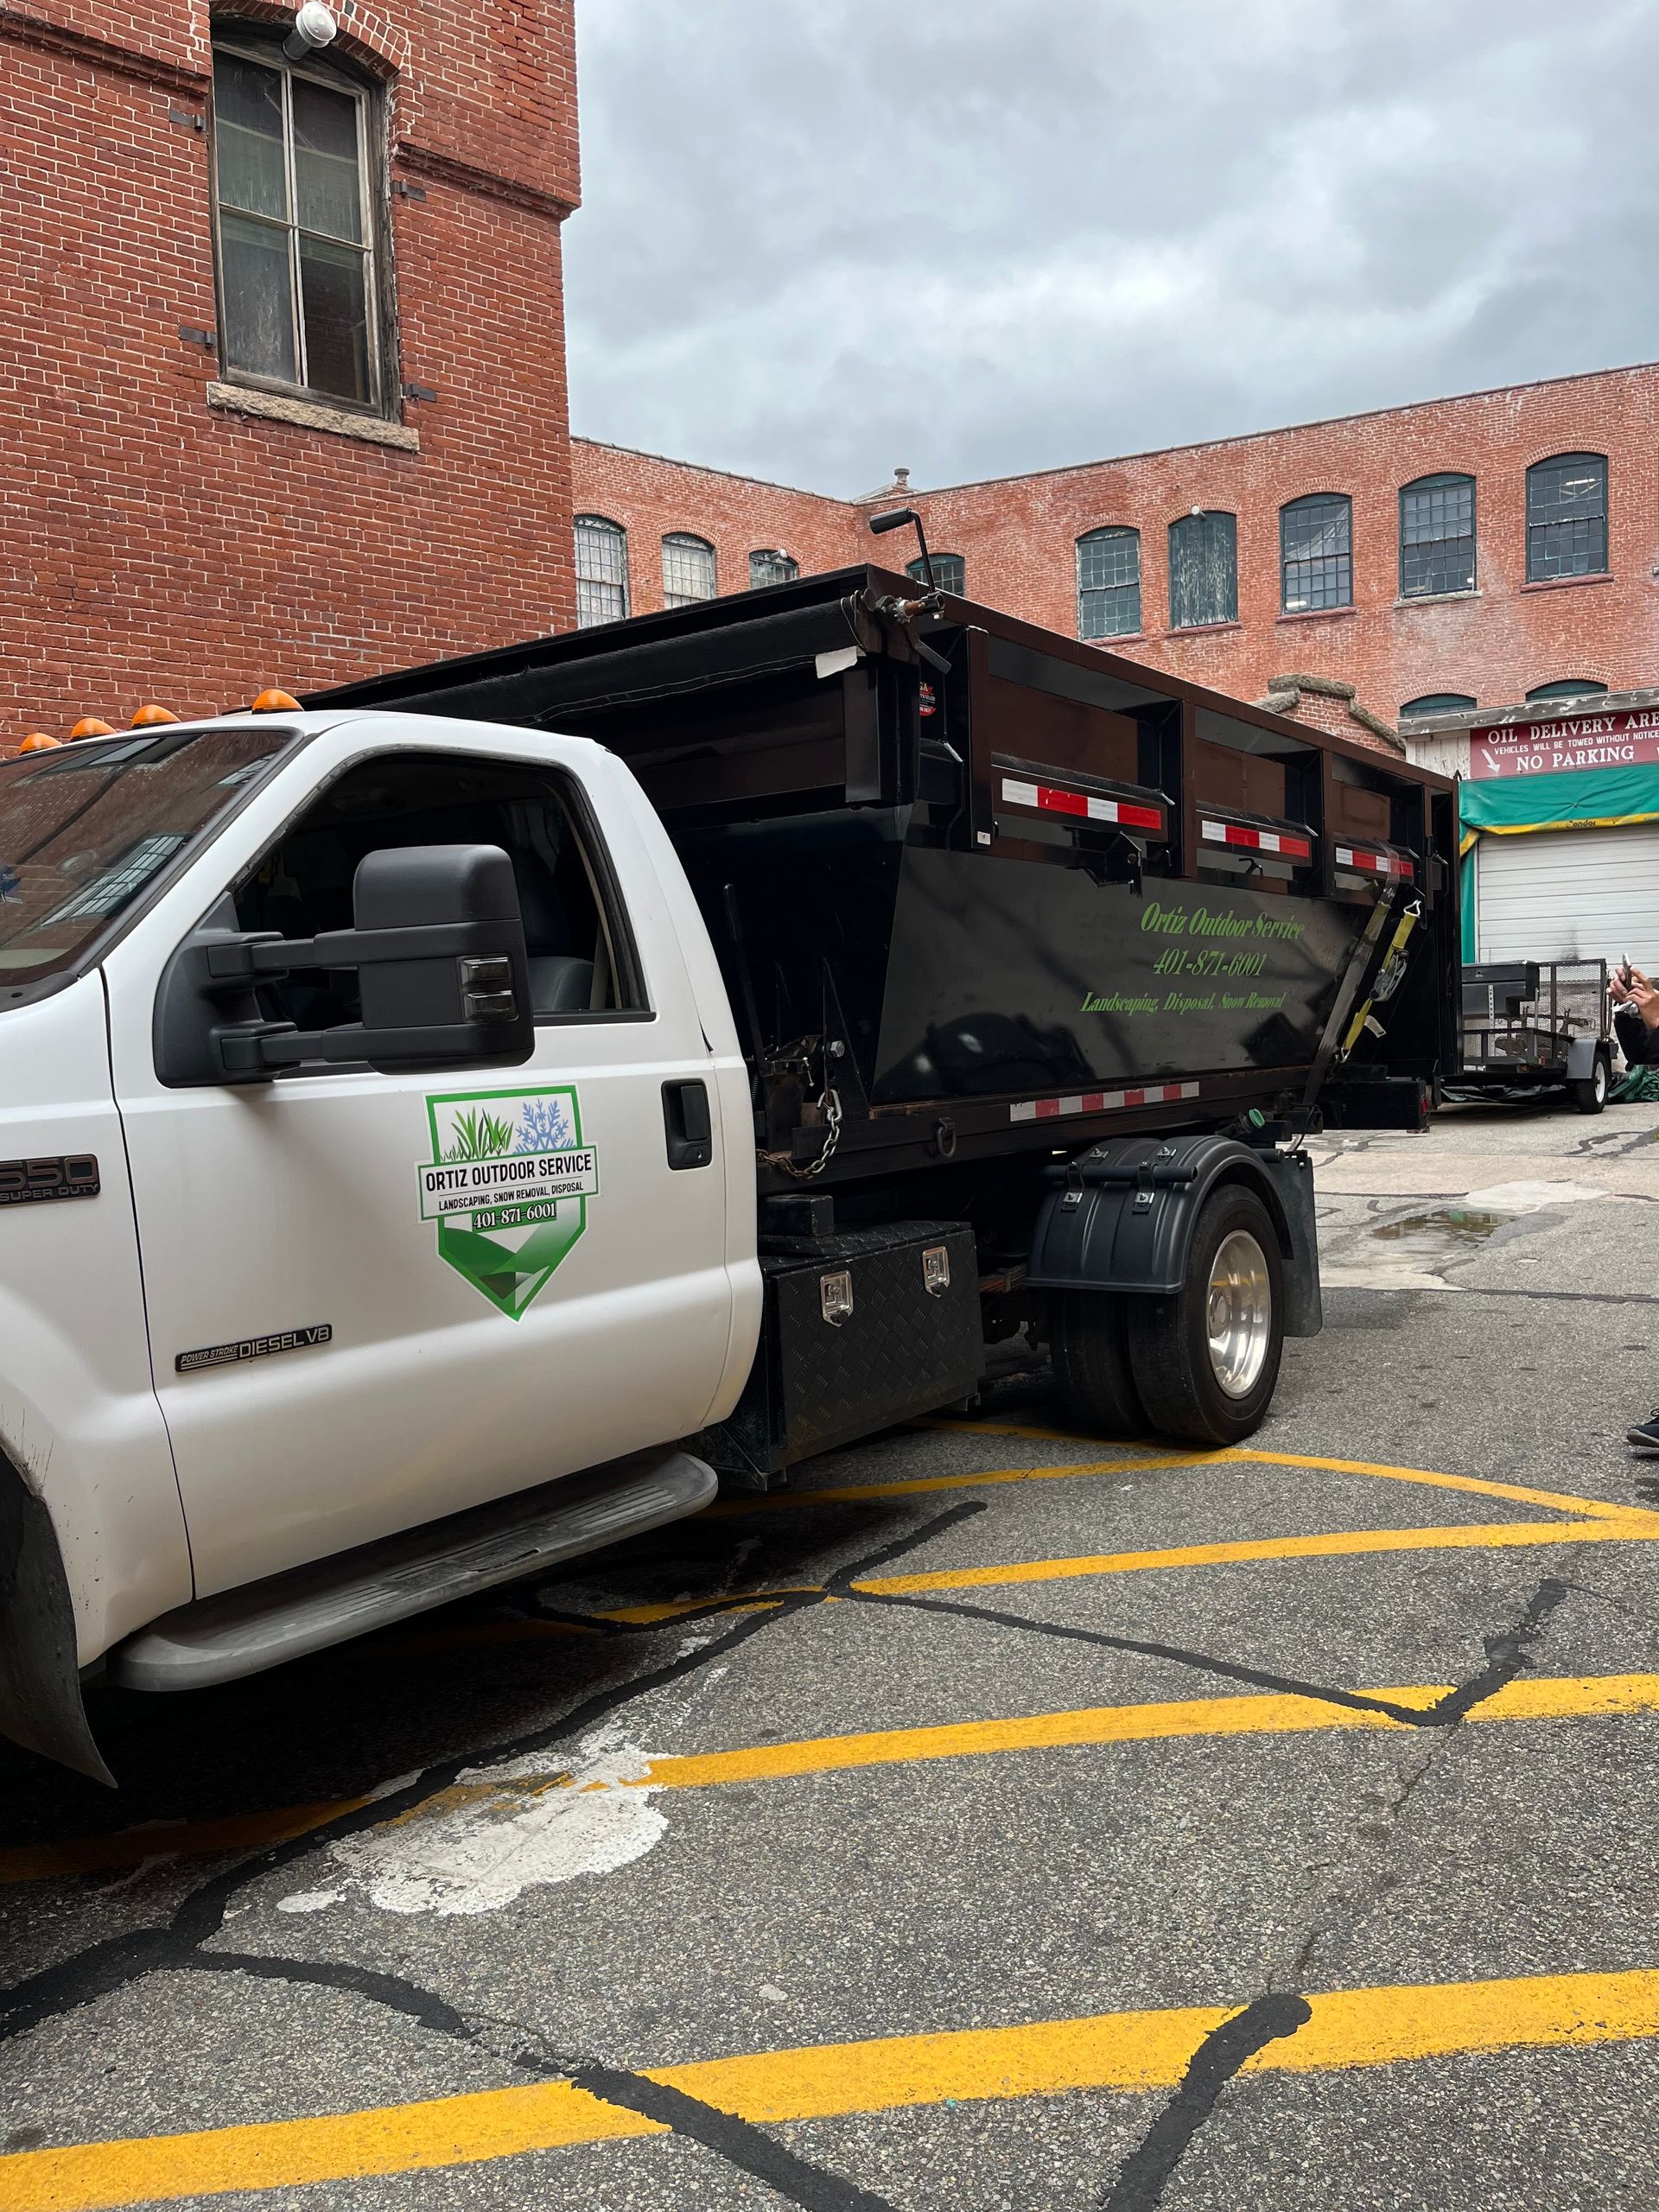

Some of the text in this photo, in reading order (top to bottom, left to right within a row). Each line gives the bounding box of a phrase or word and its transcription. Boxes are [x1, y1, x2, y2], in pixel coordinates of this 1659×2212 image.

[1488, 728, 1517, 744] OIL
[1530, 716, 1616, 741] DELIVERY
[1494, 730, 1659, 755] VEHICLES WILL BE TOWED WITHOUT NOTICE
[1516, 745, 1635, 772] NO PARKING
[1141, 902, 1306, 939] Ortiz Outdoor Service
[1153, 948, 1268, 976] 401-871-6001
[1080, 991, 1159, 1016] Landscaping,
[1219, 991, 1244, 1009] Snow
[1245, 991, 1287, 1009] Removal
[426, 1154, 592, 1192] ORTIZ OUTDOOR SERVICE
[0, 1184, 99, 1202] SUPER DUTY
[439, 1181, 583, 1211] LANDSCAPING, SNOW REMOVAL, DISPOSAL
[473, 1202, 556, 1229] 401-871-6001
[181, 1326, 329, 1363] POWER STROKE DIESEL V8
